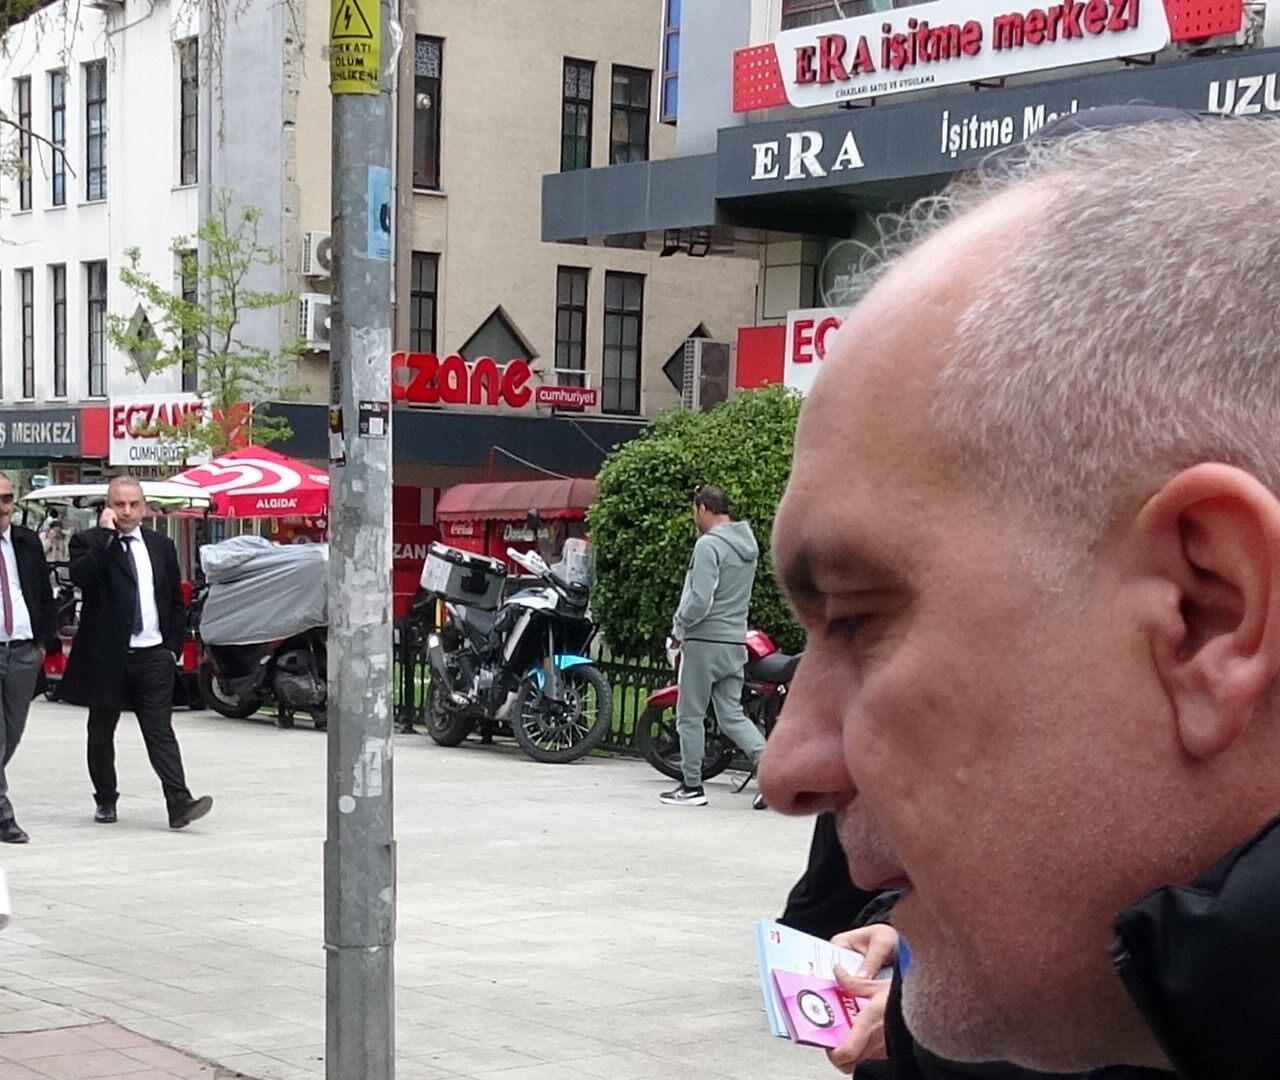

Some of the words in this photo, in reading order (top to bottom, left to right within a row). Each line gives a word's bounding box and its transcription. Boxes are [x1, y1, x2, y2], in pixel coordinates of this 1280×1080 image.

[793, 32, 876, 85] ERA
[881, 17, 982, 71] işitme
[751, 131, 865, 181] ERA
[941, 110, 1013, 158] İşitme
[392, 351, 533, 408] czane
[540, 389, 595, 405] cumhuriyet
[11, 415, 77, 444] MERKEZİ
